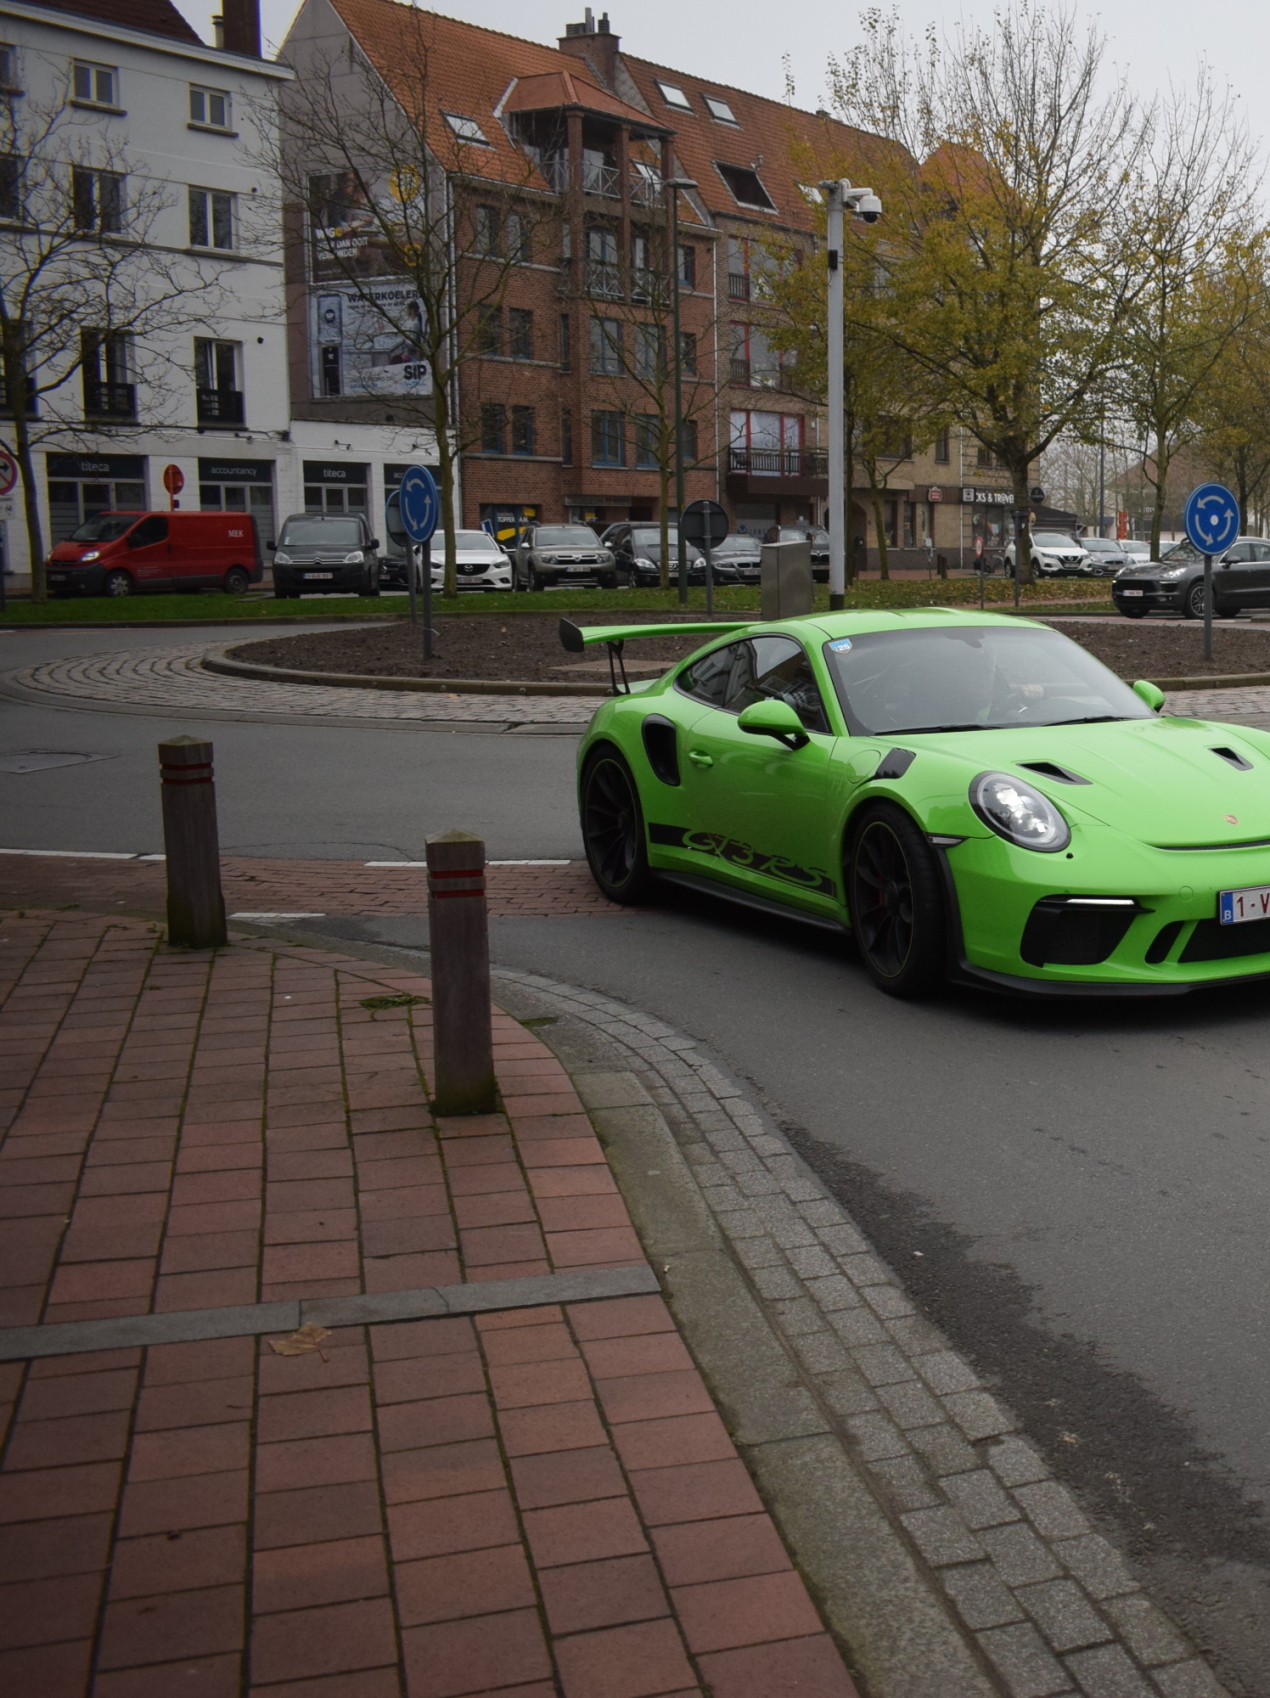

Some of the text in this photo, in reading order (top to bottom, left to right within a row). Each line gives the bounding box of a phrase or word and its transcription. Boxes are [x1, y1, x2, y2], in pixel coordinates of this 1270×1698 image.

[404, 365, 427, 380] SIP
[80, 461, 110, 472] titeca
[210, 466, 257, 477] accountancy
[323, 468, 347, 478] titeca
[682, 831, 827, 887] GT3 RS
[1224, 910, 1232, 920] B
